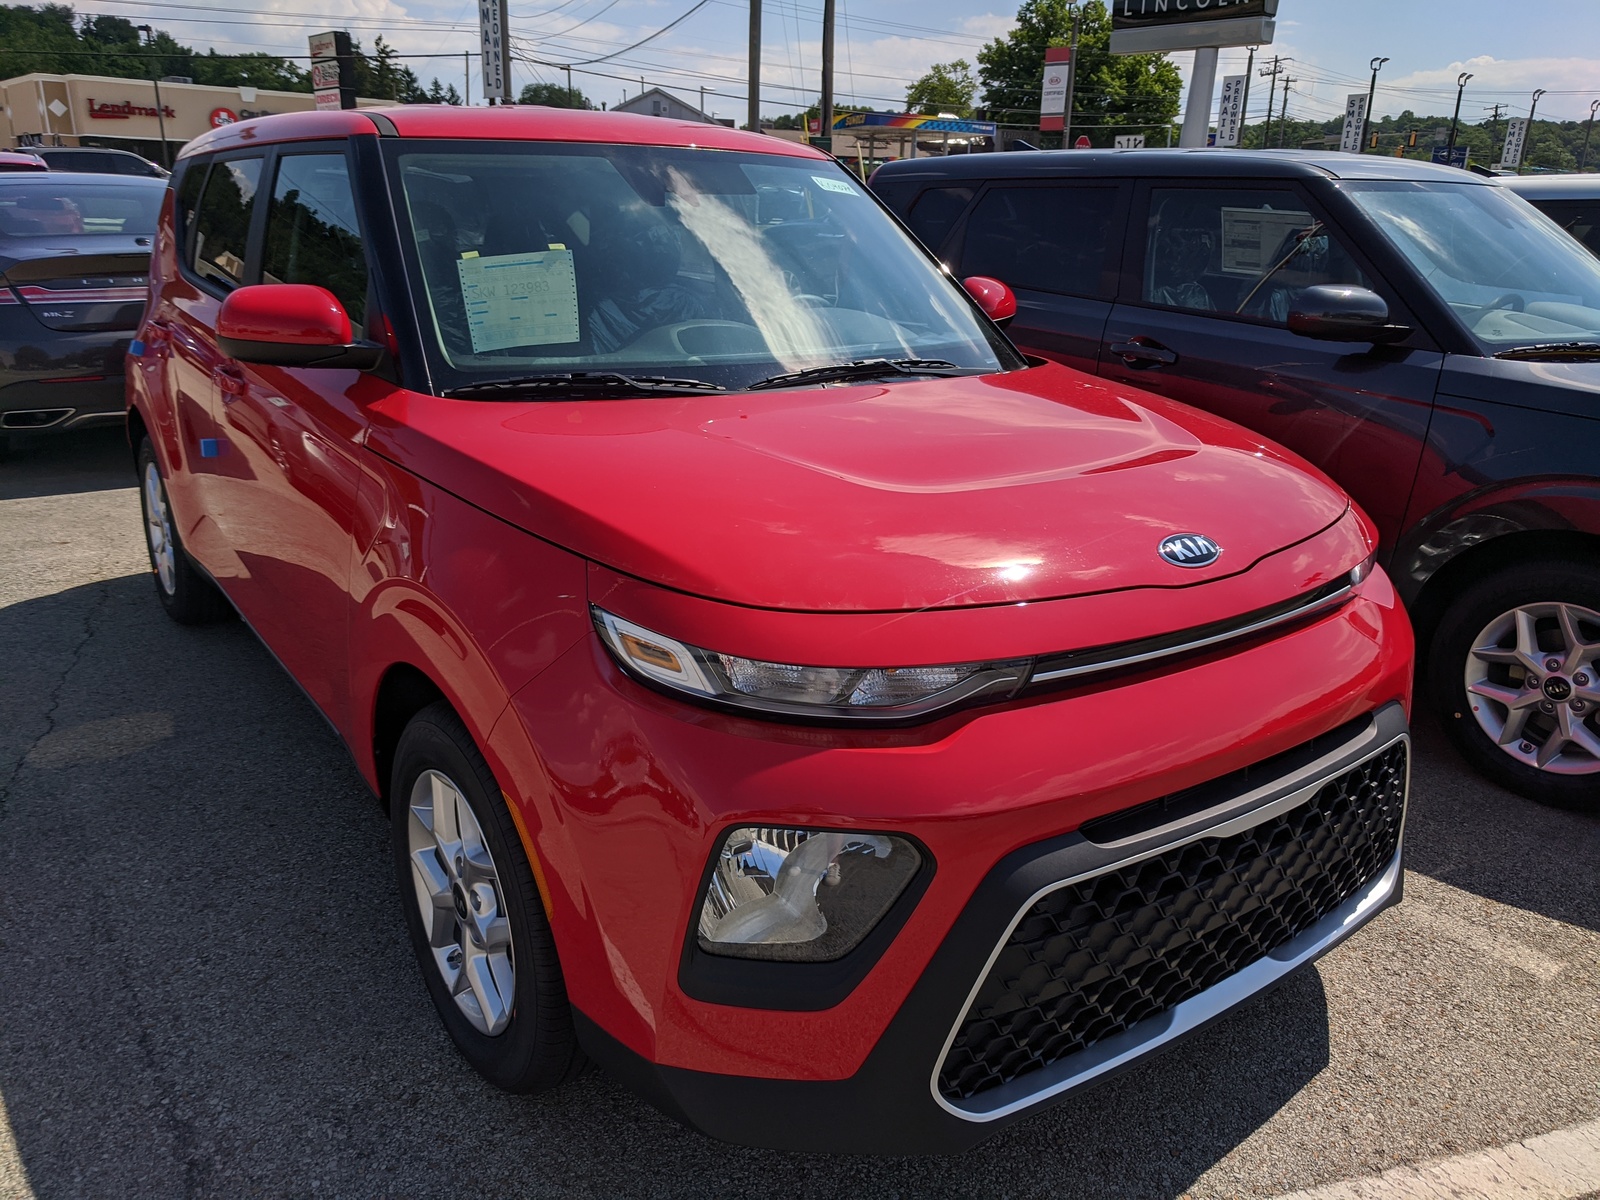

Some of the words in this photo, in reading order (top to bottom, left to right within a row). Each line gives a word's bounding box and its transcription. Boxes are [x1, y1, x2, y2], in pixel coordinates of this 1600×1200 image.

[482, 0, 492, 87] MAIL
[492, 0, 502, 89] REOWNED
[87, 98, 176, 118] Lendmark
[1220, 83, 1232, 139] SMAIL
[1229, 80, 1241, 141] PREOWNED
[1343, 99, 1356, 149] SMAIL
[1352, 97, 1364, 151] PREOWNED
[1504, 122, 1516, 163] SMAIL
[1511, 121, 1524, 164] PREOWNED
[503, 281, 550, 296] 123983
[1165, 536, 1216, 560] KIA
